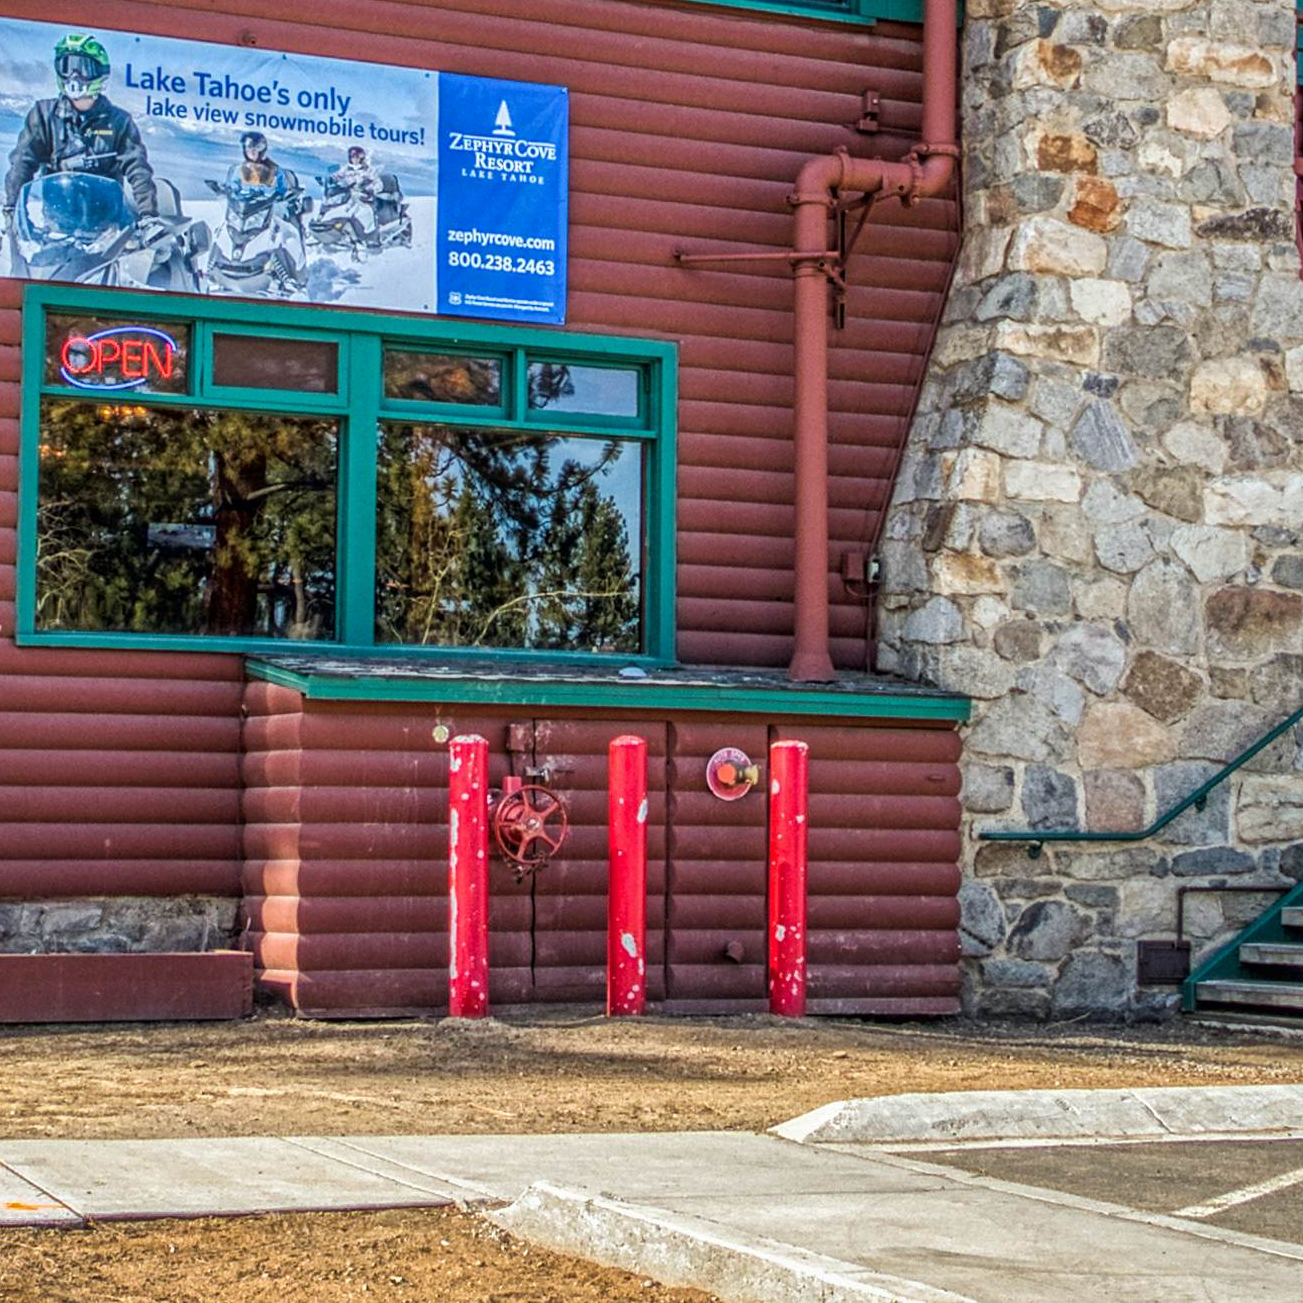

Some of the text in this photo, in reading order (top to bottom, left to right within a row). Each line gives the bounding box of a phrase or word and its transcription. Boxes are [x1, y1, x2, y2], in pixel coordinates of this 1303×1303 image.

[125, 63, 351, 117] Lake Tahoe's only
[147, 95, 426, 146] lake view snowmobile tours!
[474, 152, 534, 174] RESORT
[461, 168, 545, 185] LAKE TAHOE
[448, 228, 555, 251] zephyrcove.com
[449, 251, 555, 276] 800.238.2463
[61, 337, 173, 378] OPEN
